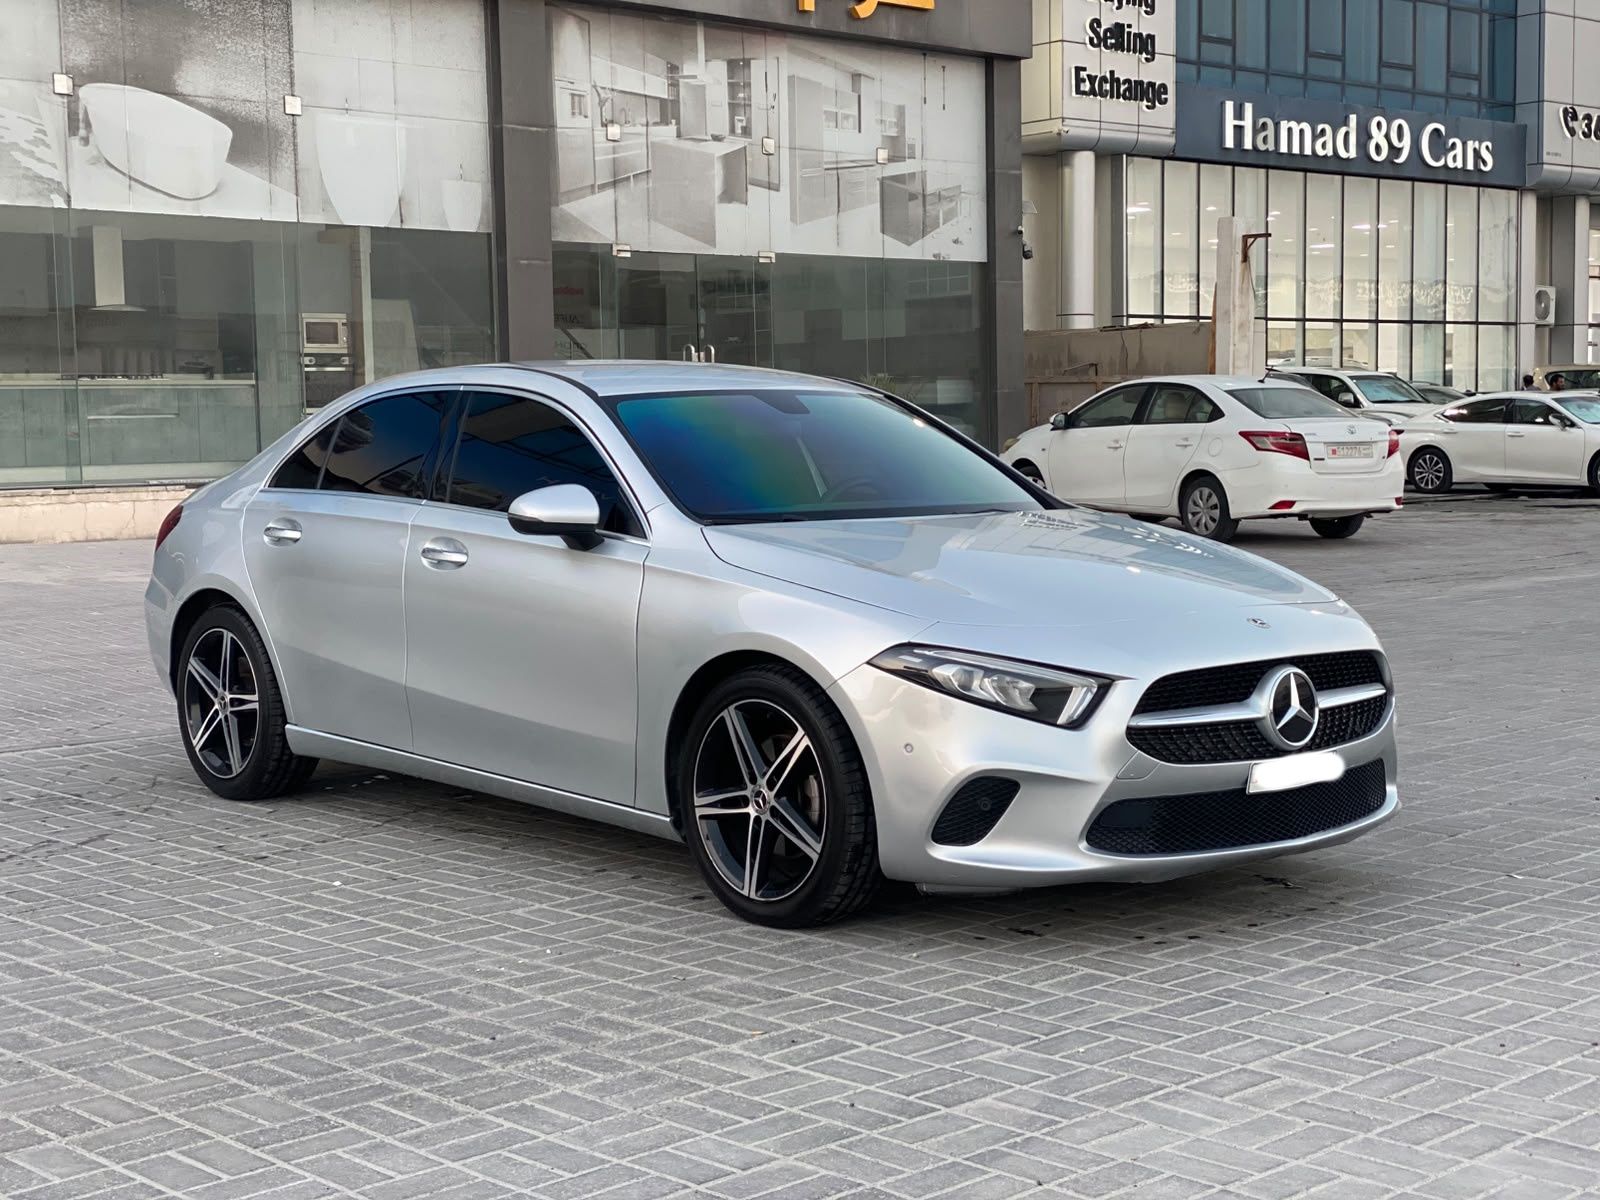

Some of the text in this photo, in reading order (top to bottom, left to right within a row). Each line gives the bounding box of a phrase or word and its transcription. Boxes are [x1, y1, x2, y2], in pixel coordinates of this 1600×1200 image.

[1087, 17, 1155, 63] Selling
[1072, 66, 1169, 110] Exchange
[1222, 100, 1494, 172] Hamad 89 Cars
